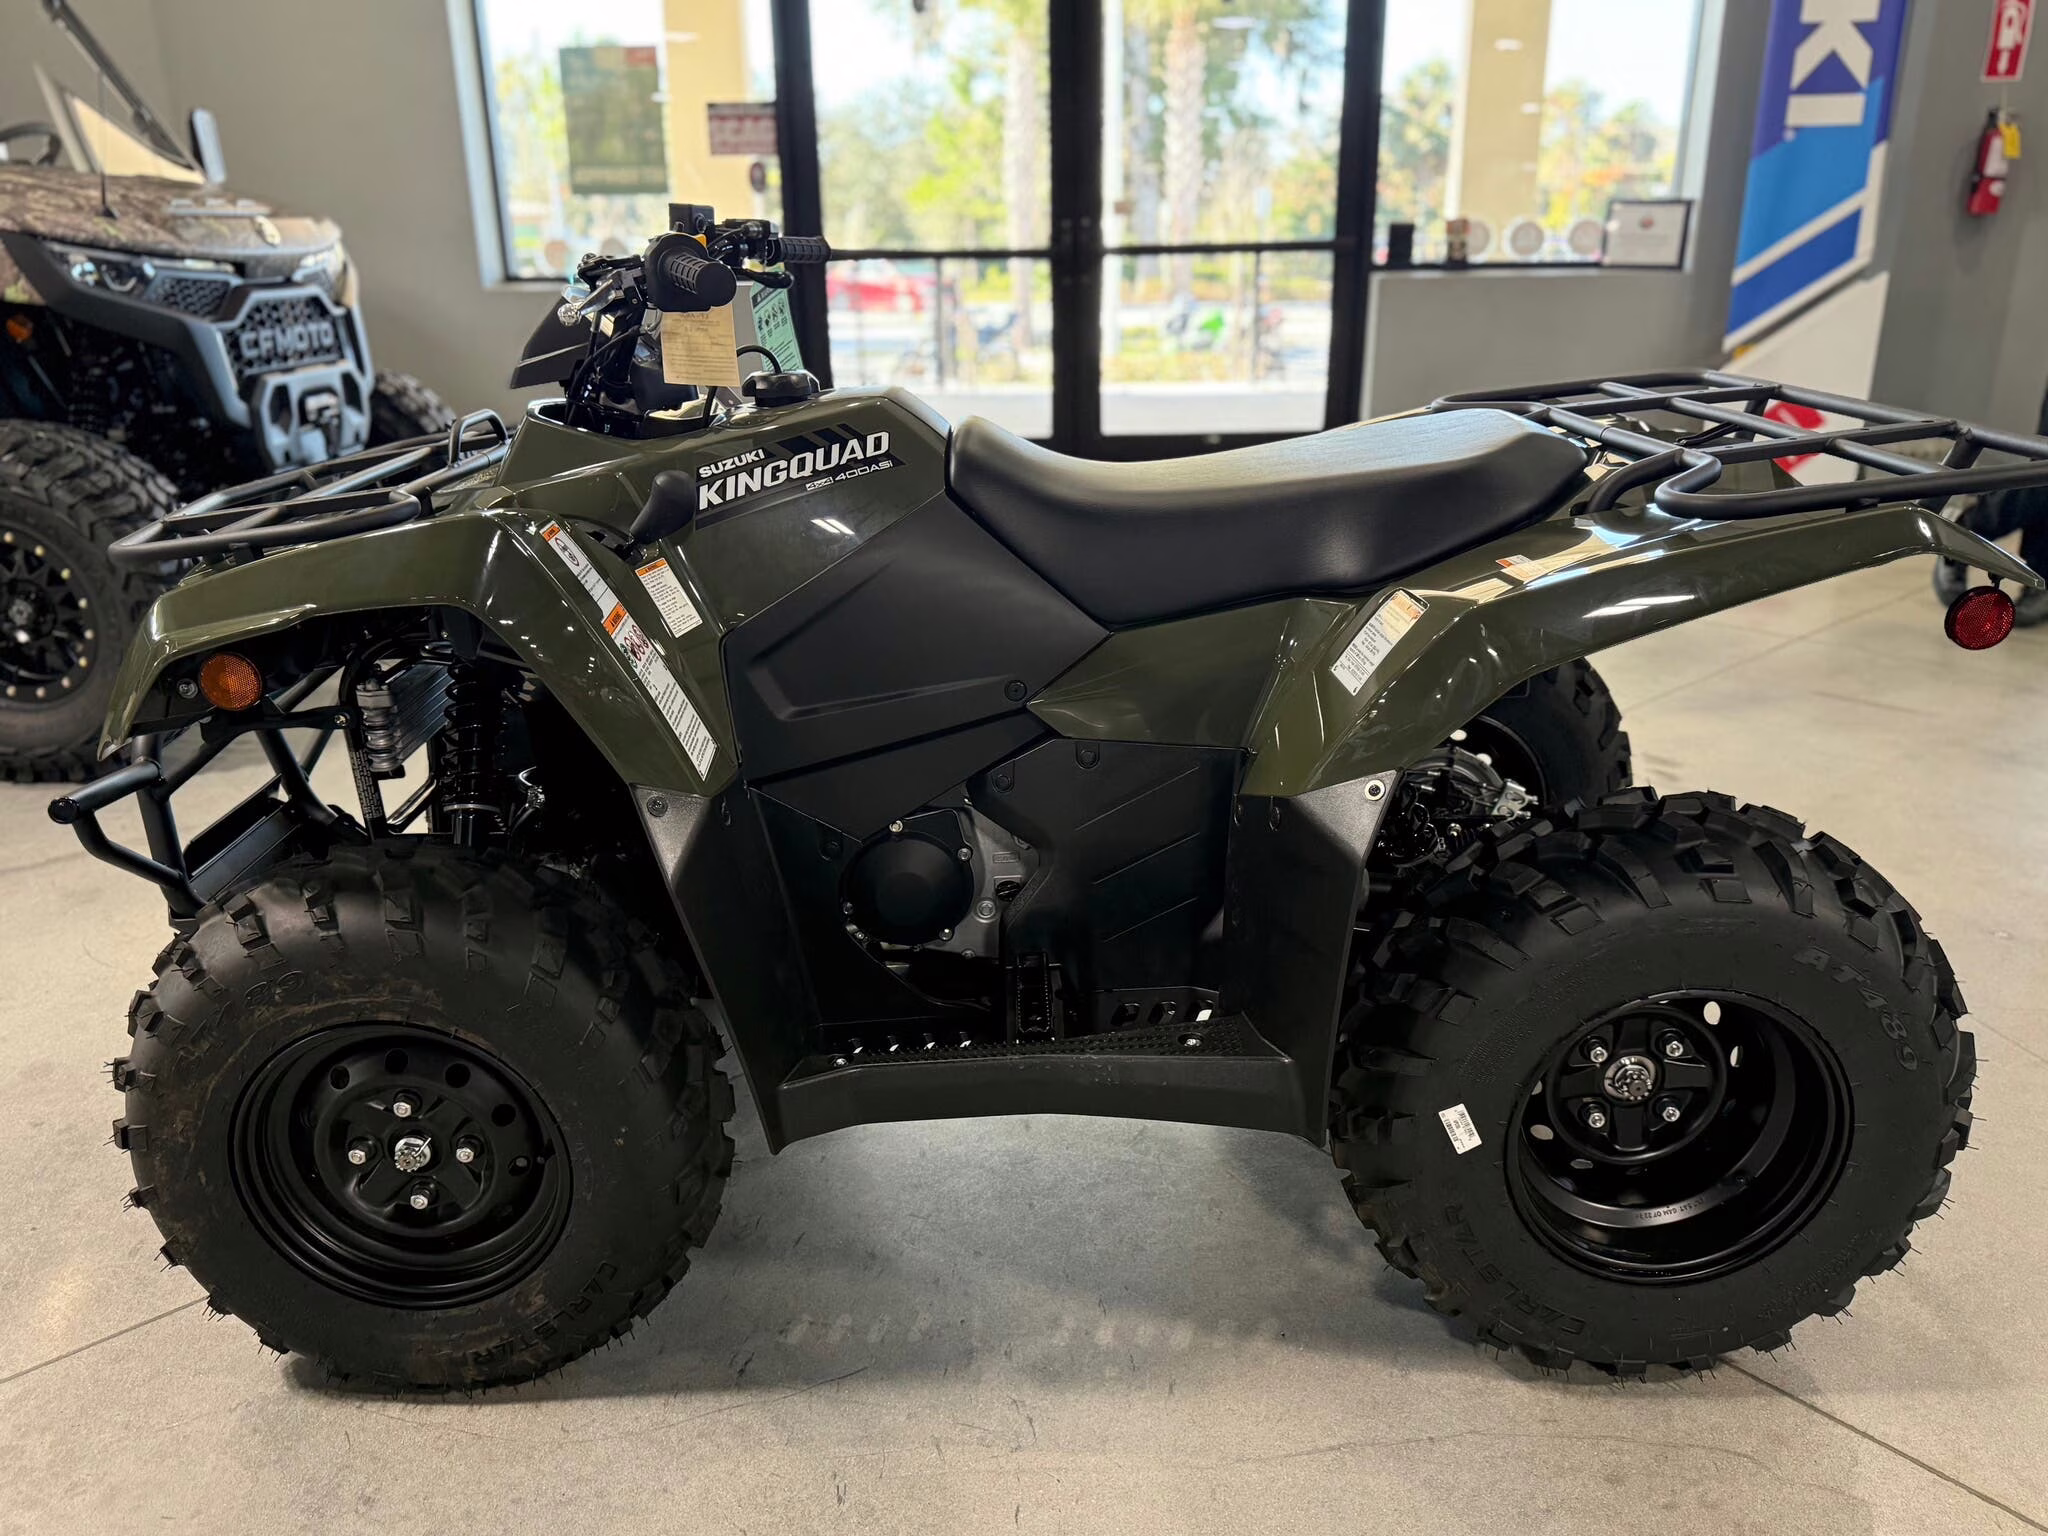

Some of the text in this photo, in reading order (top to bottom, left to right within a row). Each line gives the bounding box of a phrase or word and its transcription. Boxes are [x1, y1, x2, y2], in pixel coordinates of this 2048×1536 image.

[240, 320, 335, 359] CFMOTO
[699, 449, 764, 478] SUZUKI
[699, 431, 890, 511] KINGQUAD
